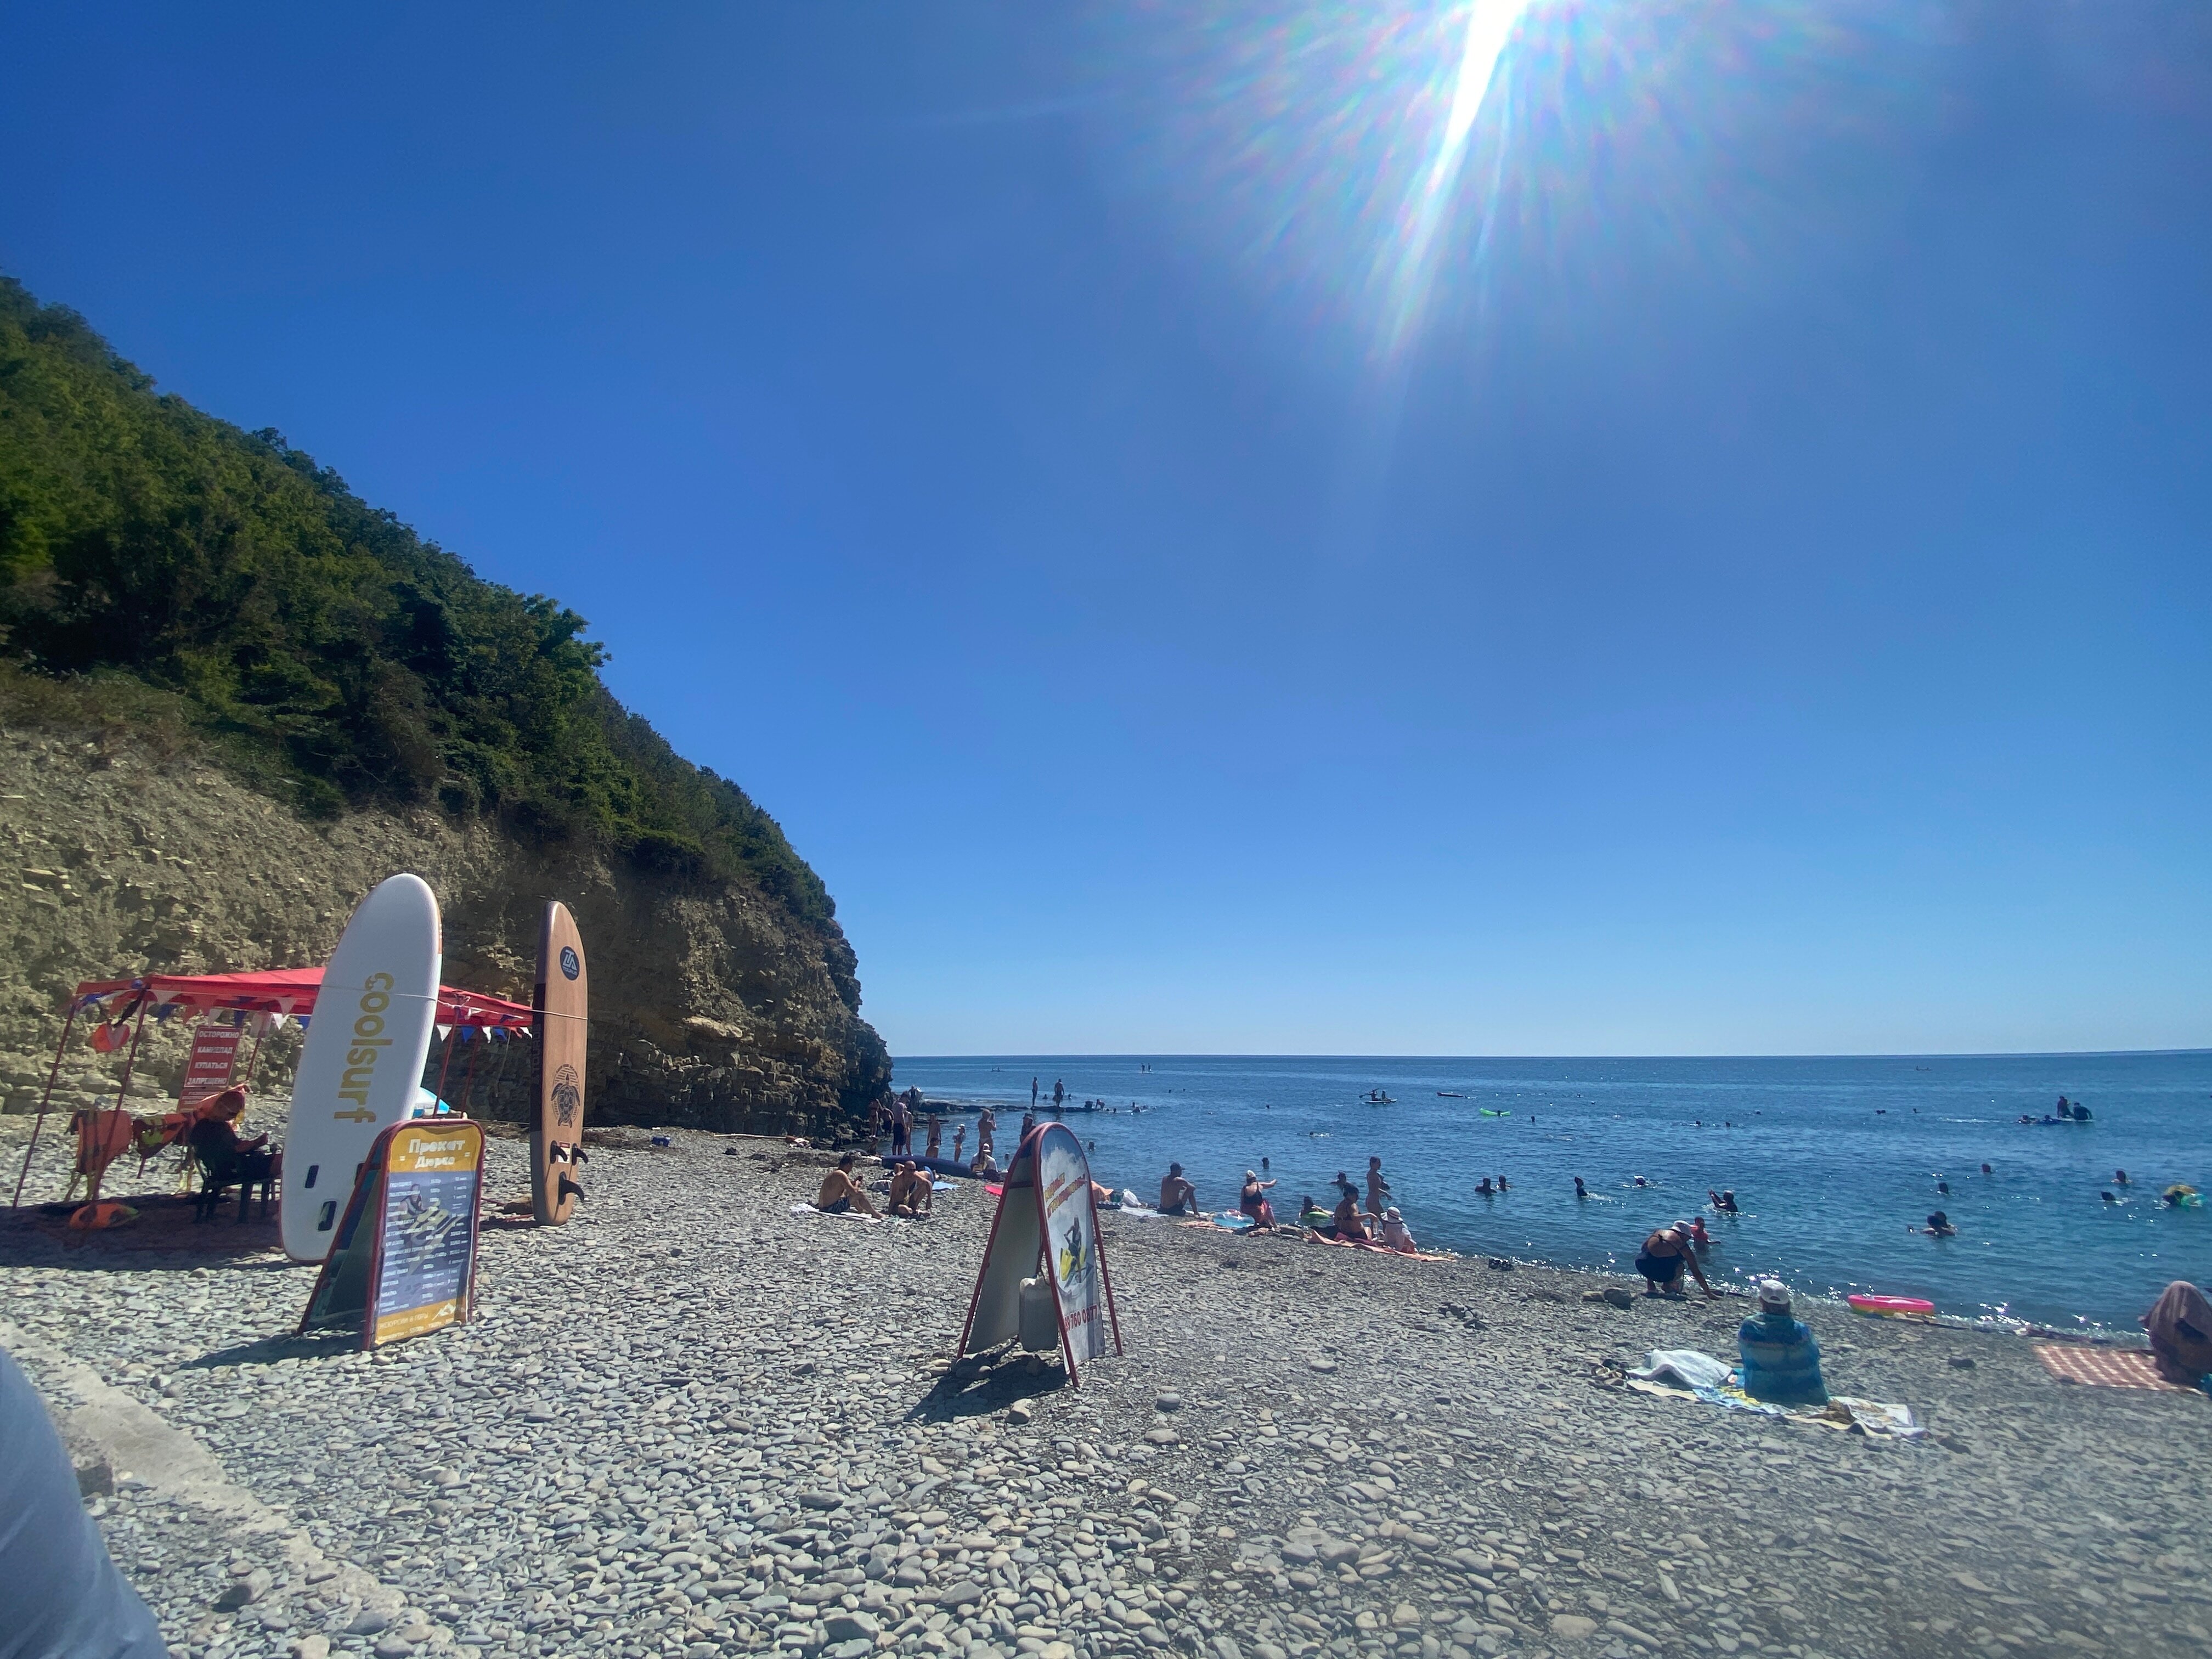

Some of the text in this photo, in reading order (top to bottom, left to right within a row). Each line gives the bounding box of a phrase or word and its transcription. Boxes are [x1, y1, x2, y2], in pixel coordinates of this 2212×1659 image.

[334, 972, 394, 1124] coolsurf
[409, 1138, 465, 1155] Прокат
[1070, 1310, 1081, 1329] 760
[1082, 1304, 1098, 1324] 0877
